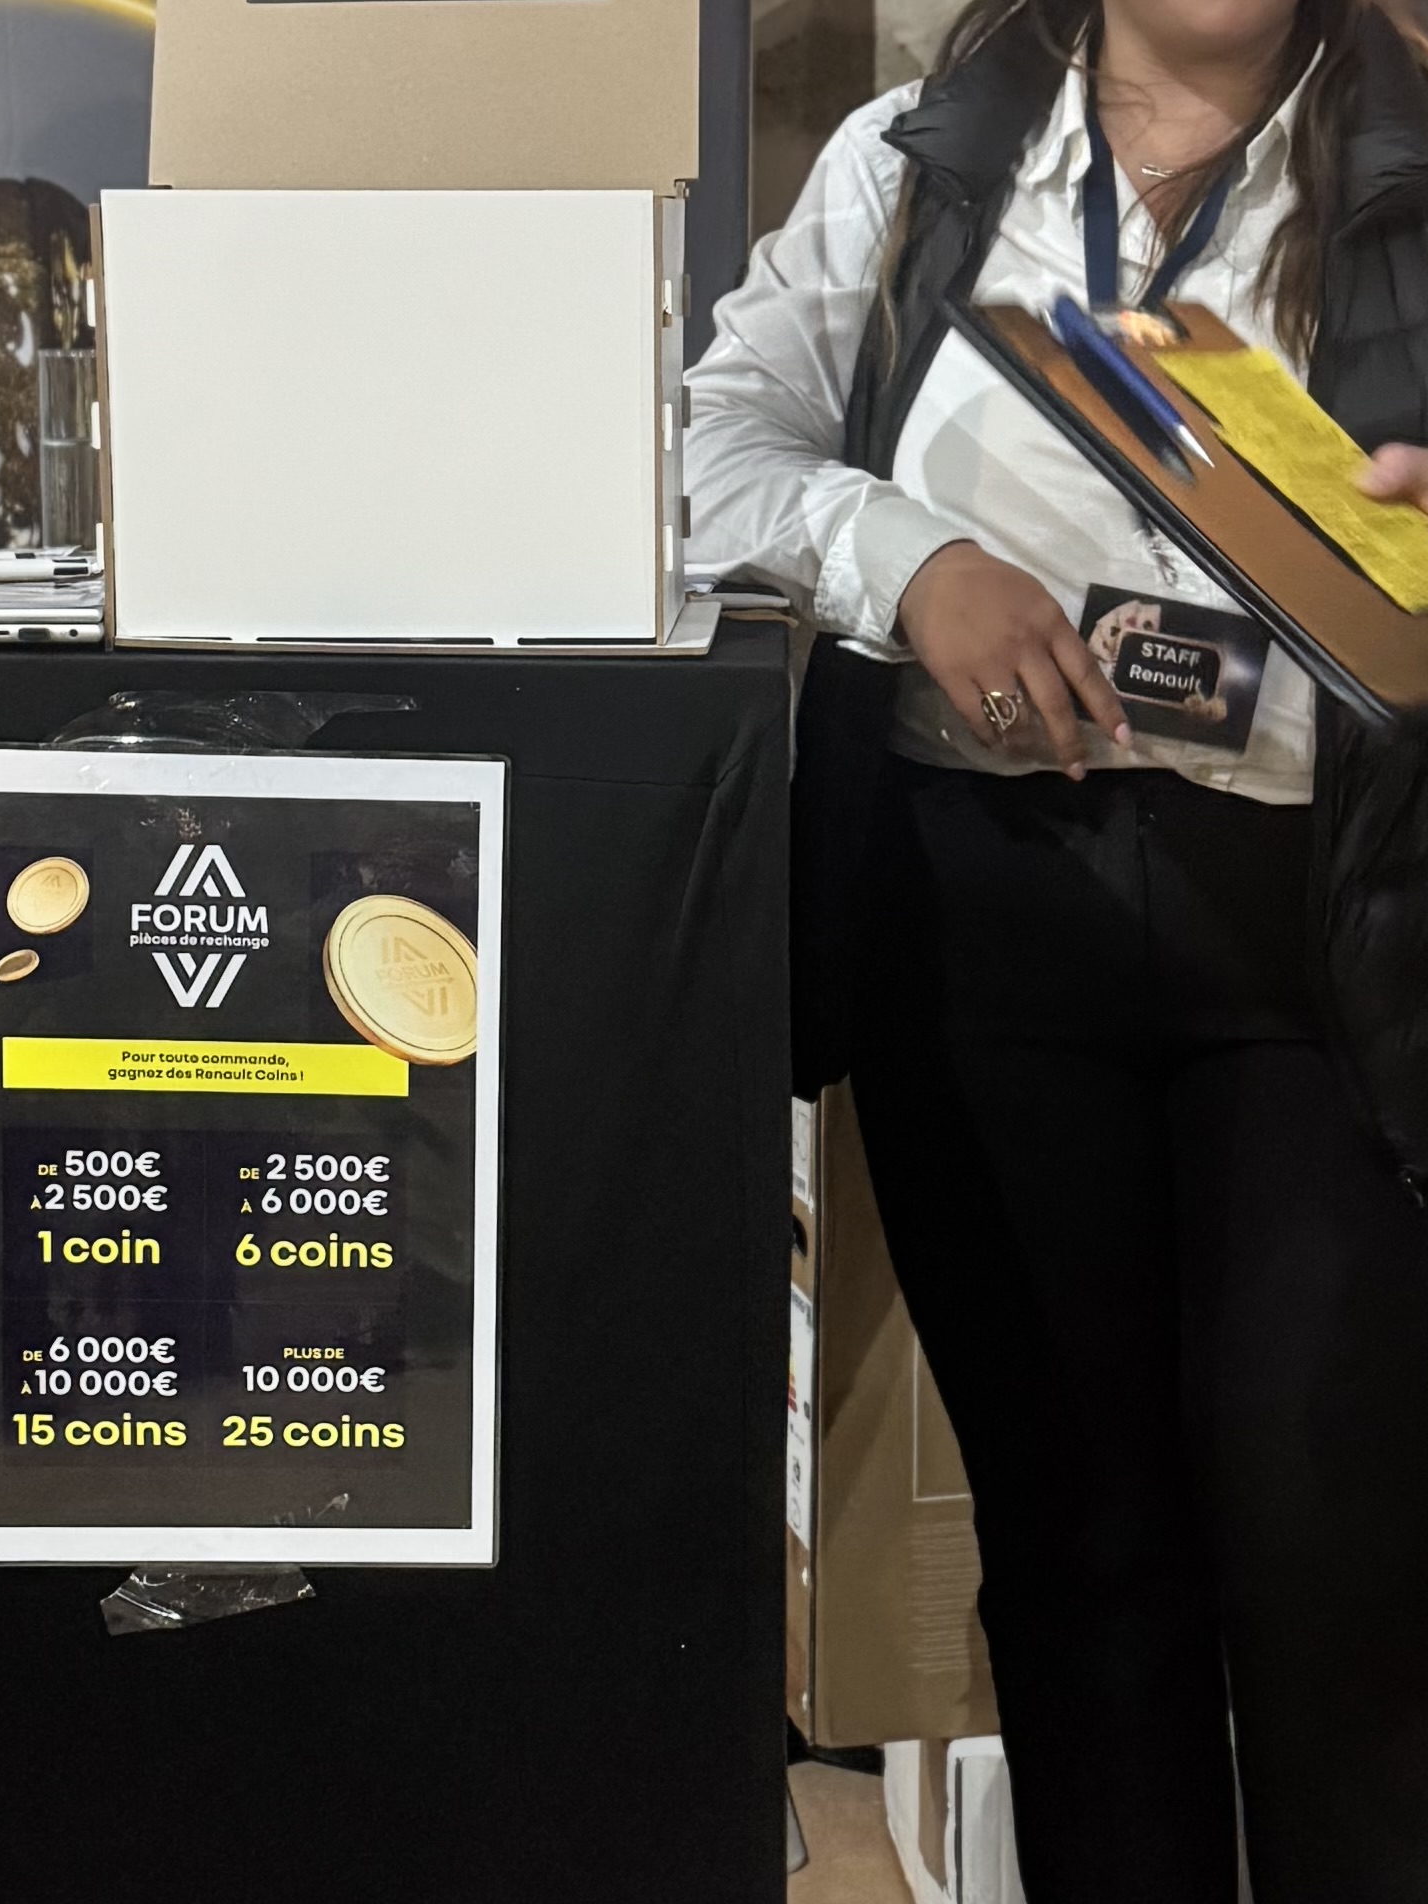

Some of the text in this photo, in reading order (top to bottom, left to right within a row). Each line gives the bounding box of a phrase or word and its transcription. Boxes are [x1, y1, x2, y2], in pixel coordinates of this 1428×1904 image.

[1140, 640, 1202, 668] STAFF
[1128, 663, 1202, 693] Renault
[130, 903, 270, 935] FORUM
[129, 932, 270, 950] pièces de rechange
[121, 1051, 291, 1068] Pour toute commande,
[107, 1067, 164, 1082] gagnez
[165, 1067, 193, 1080] des
[195, 1068, 253, 1081] Renault
[37, 1149, 162, 1179] DE 500€
[239, 1167, 260, 1180] DE
[37, 1228, 162, 1265] 1 coin
[235, 1231, 395, 1269] 6 coins
[22, 1349, 43, 1363] DE
[283, 1346, 345, 1360] PLUS DE
[11, 1411, 188, 1448] 15 coins
[222, 1413, 406, 1449] 25 coins
